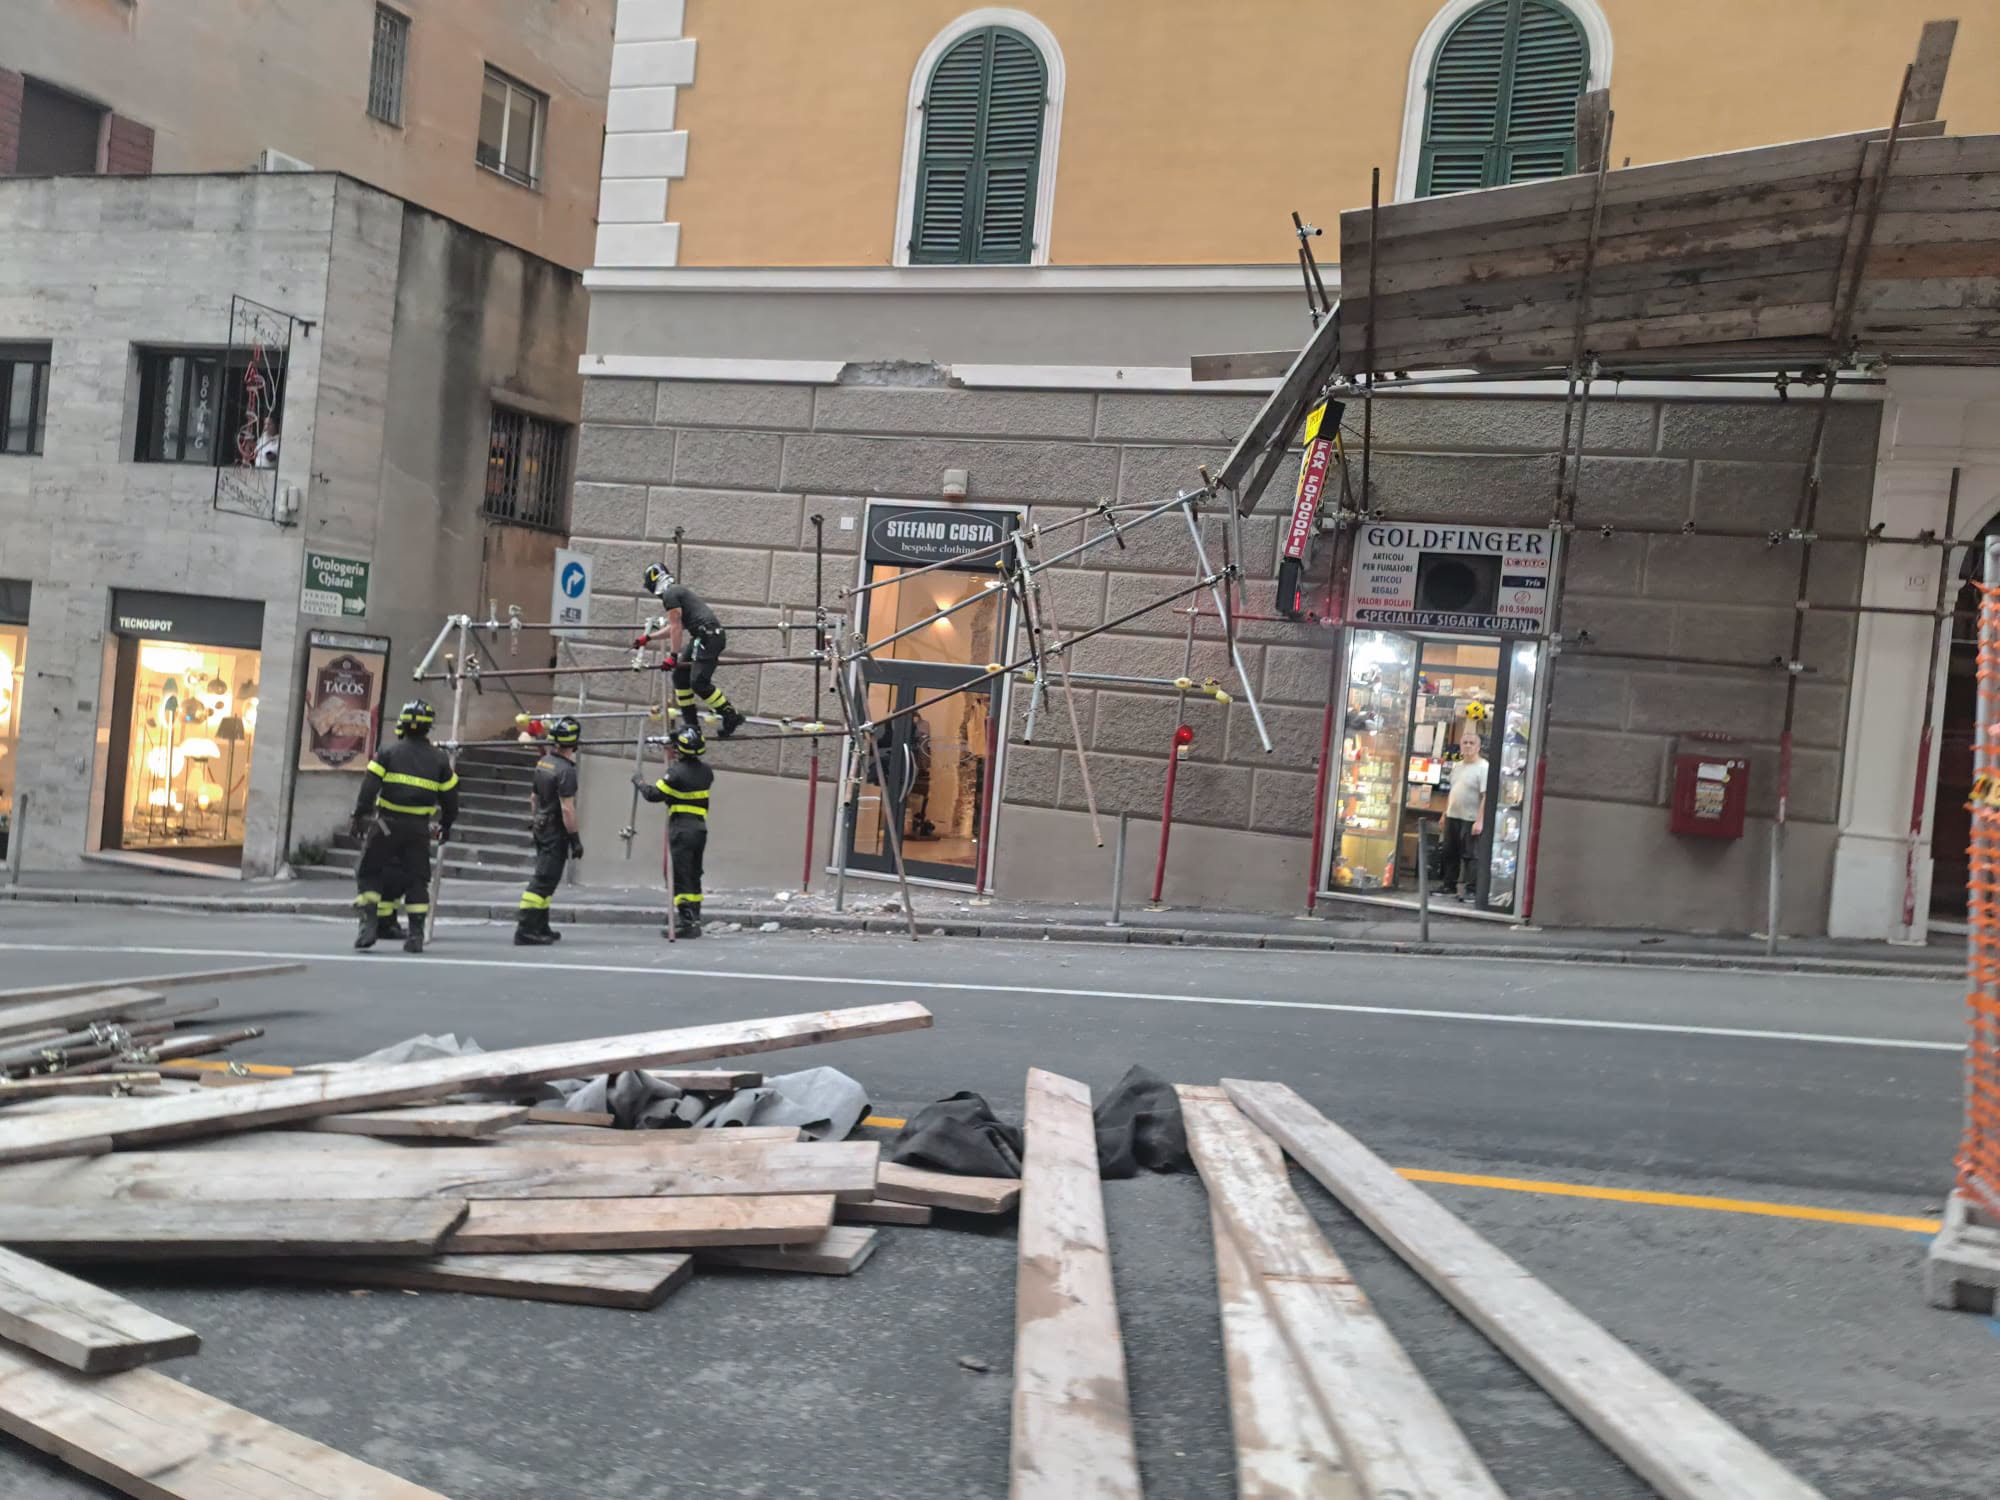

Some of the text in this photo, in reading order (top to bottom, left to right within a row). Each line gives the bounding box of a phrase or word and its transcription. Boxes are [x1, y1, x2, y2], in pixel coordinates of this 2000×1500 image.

[1312, 441, 1328, 469] FAX
[1288, 475, 1318, 555] FOTOCOPIE
[887, 520, 994, 542] STEFANO COSTA
[901, 542, 937, 553] bespoke
[1367, 528, 1542, 554] GOLDFINGER
[1373, 552, 1404, 561] ARTICOLI
[312, 556, 365, 577] Orologeria
[1377, 564, 1413, 573] FUMATORI
[319, 571, 354, 589] Chiarai
[1370, 575, 1402, 584] ARTICOLI
[1372, 586, 1399, 595] REGALO
[1357, 597, 1412, 608] VALORI BOLLATI
[119, 616, 173, 632] TECNOSPOT
[1437, 615, 1479, 628] SIGARI
[1484, 616, 1534, 632] CUBANI
[323, 680, 365, 695] TACOS
